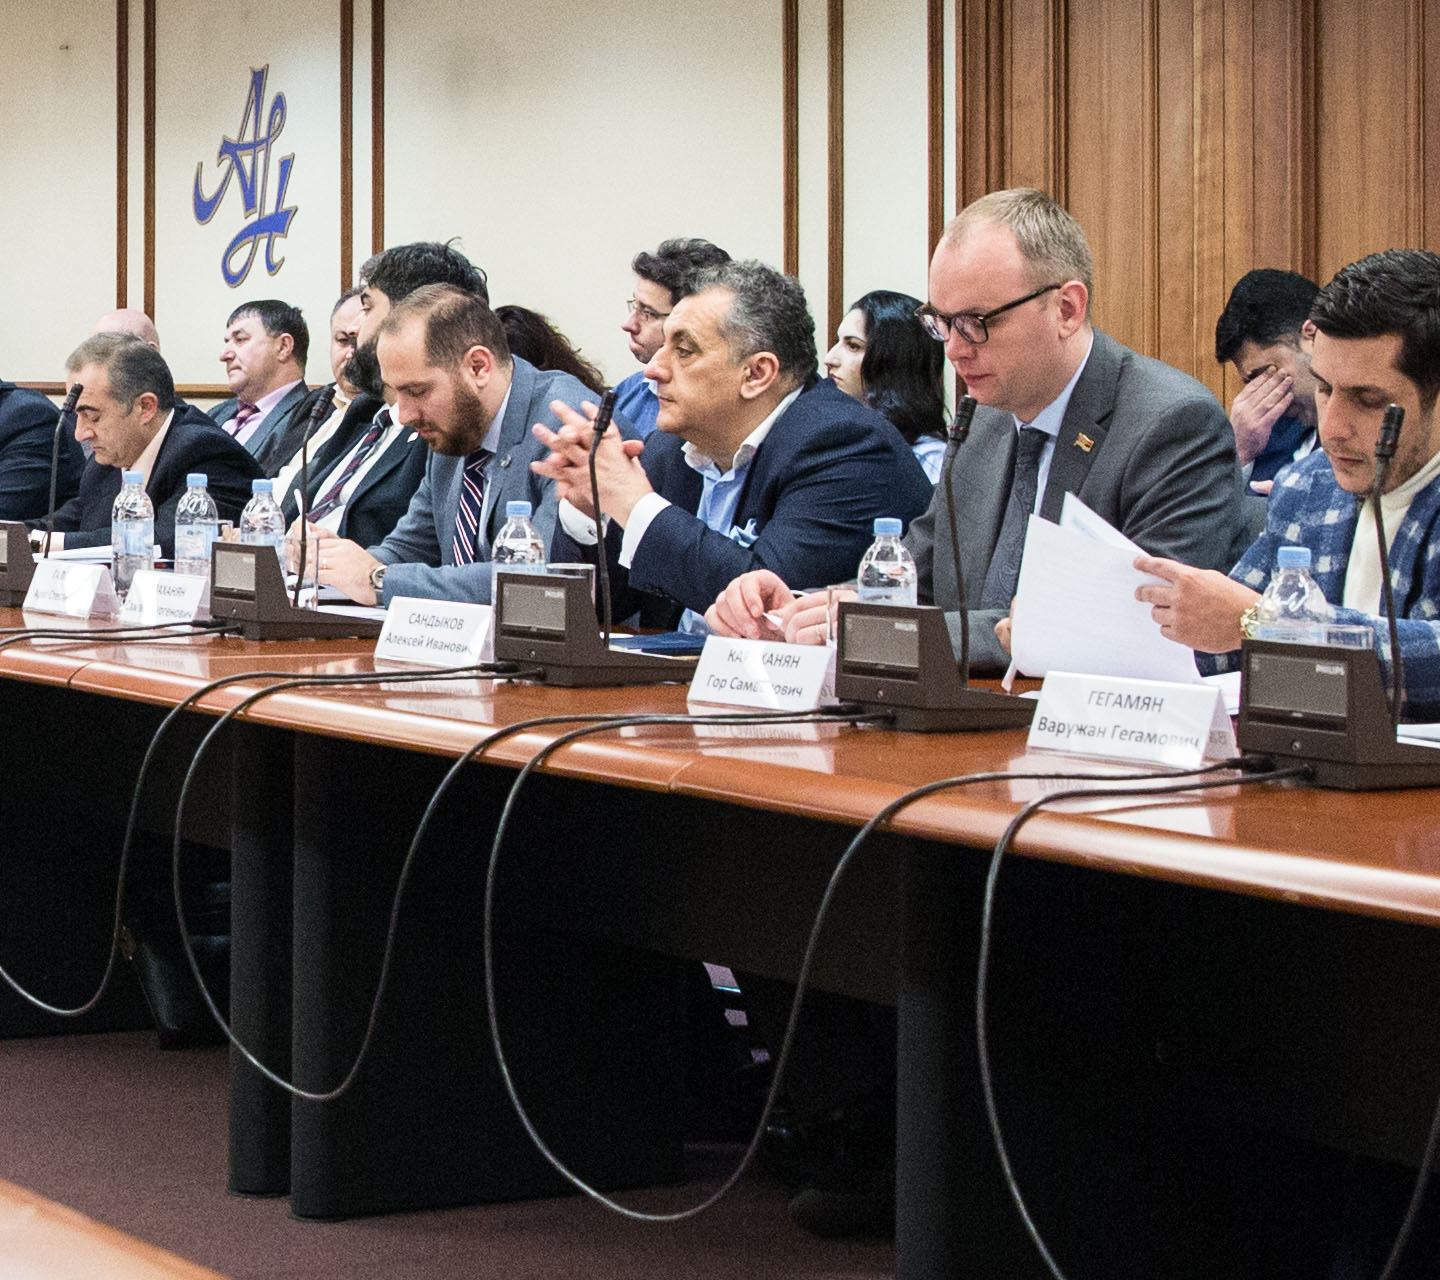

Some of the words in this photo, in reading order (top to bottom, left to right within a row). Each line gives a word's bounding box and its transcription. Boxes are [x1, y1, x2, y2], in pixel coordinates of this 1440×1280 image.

[408, 613, 464, 630] САНДЫКОВ
[385, 632, 424, 646] Алексей
[425, 635, 471, 654] Иванови
[706, 674, 728, 691] Гор
[1087, 690, 1165, 712] ГЕГАМЯН
[1037, 716, 1106, 738] Варужан
[1109, 725, 1200, 749] Гегамович
